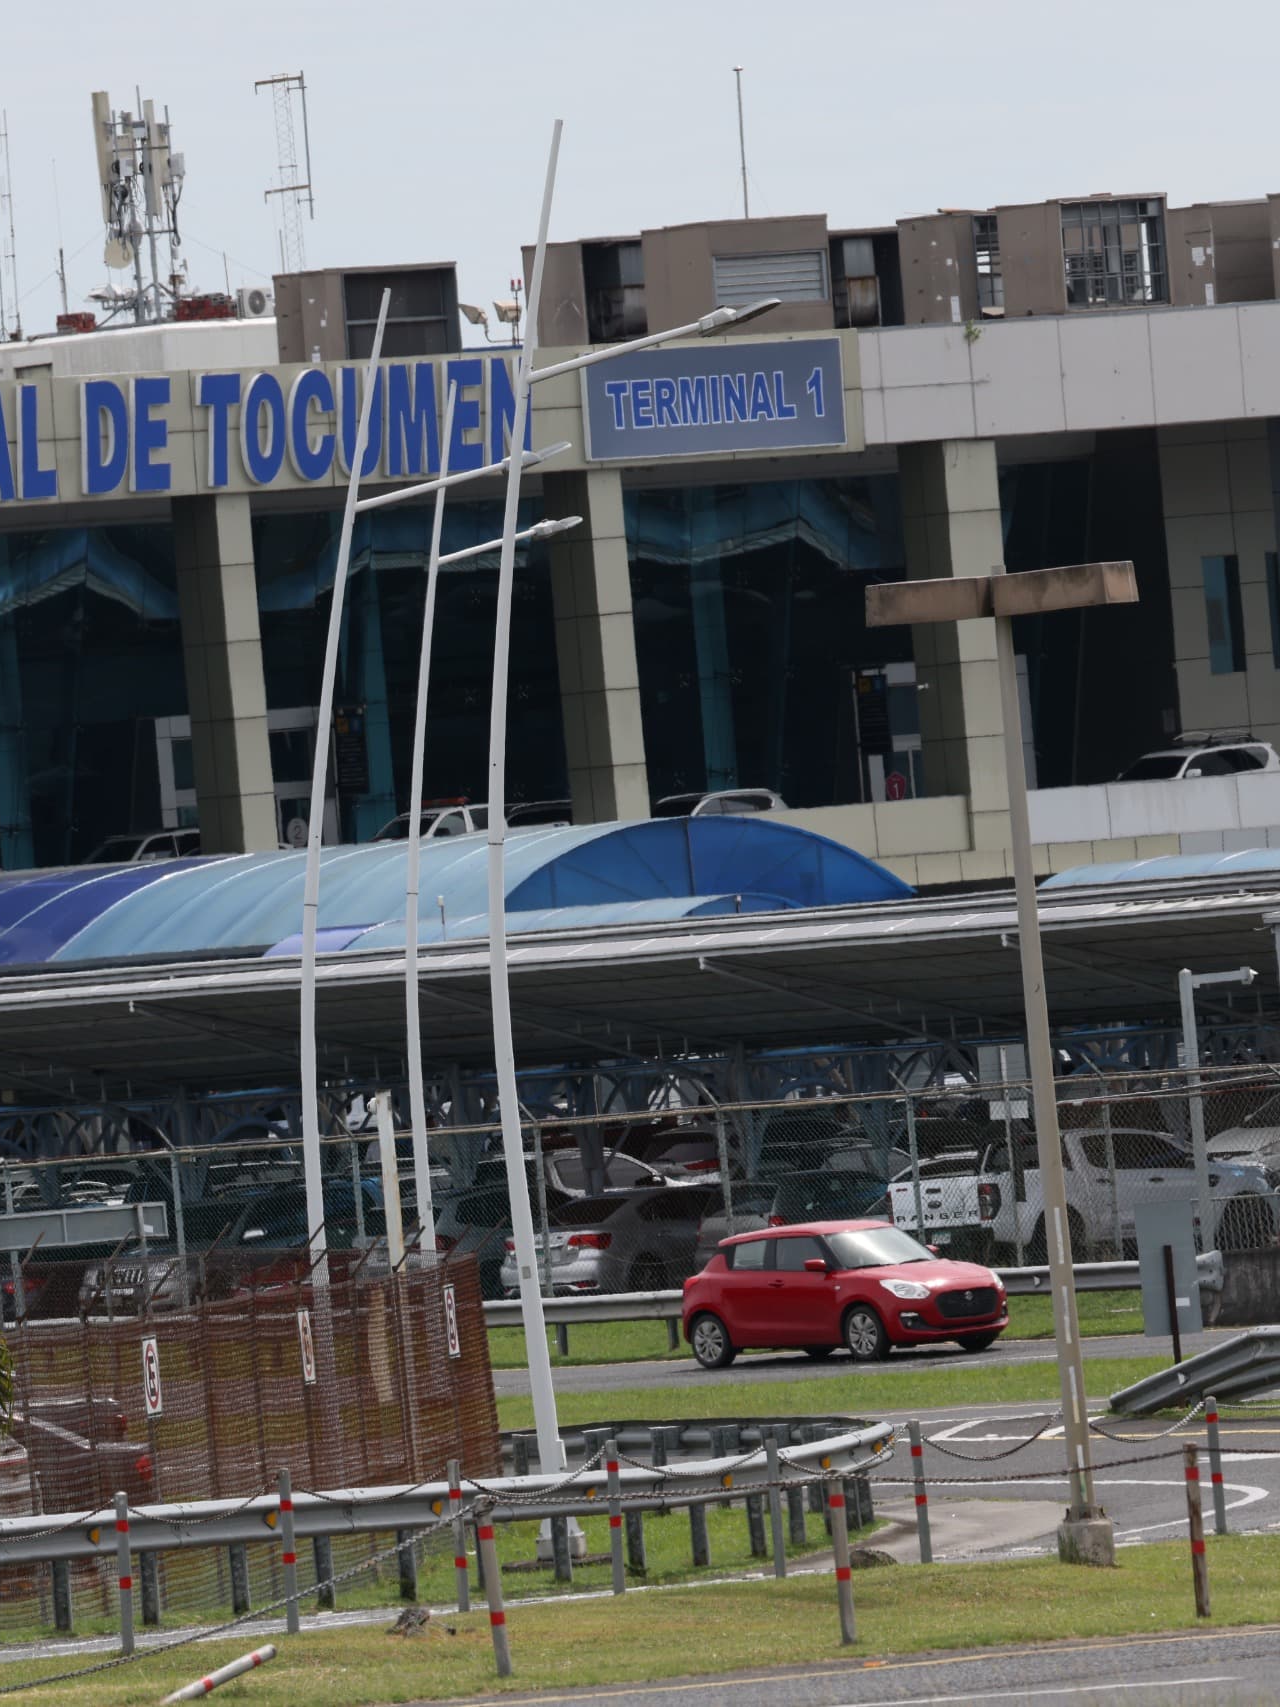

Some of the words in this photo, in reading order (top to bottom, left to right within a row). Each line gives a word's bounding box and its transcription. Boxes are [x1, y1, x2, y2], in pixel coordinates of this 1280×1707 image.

[80, 376, 171, 495] DE
[195, 358, 531, 484] TOCUMEN
[605, 371, 797, 430] TERMINAL
[806, 367, 825, 417] 1
[895, 1210, 978, 1223] RANGER
